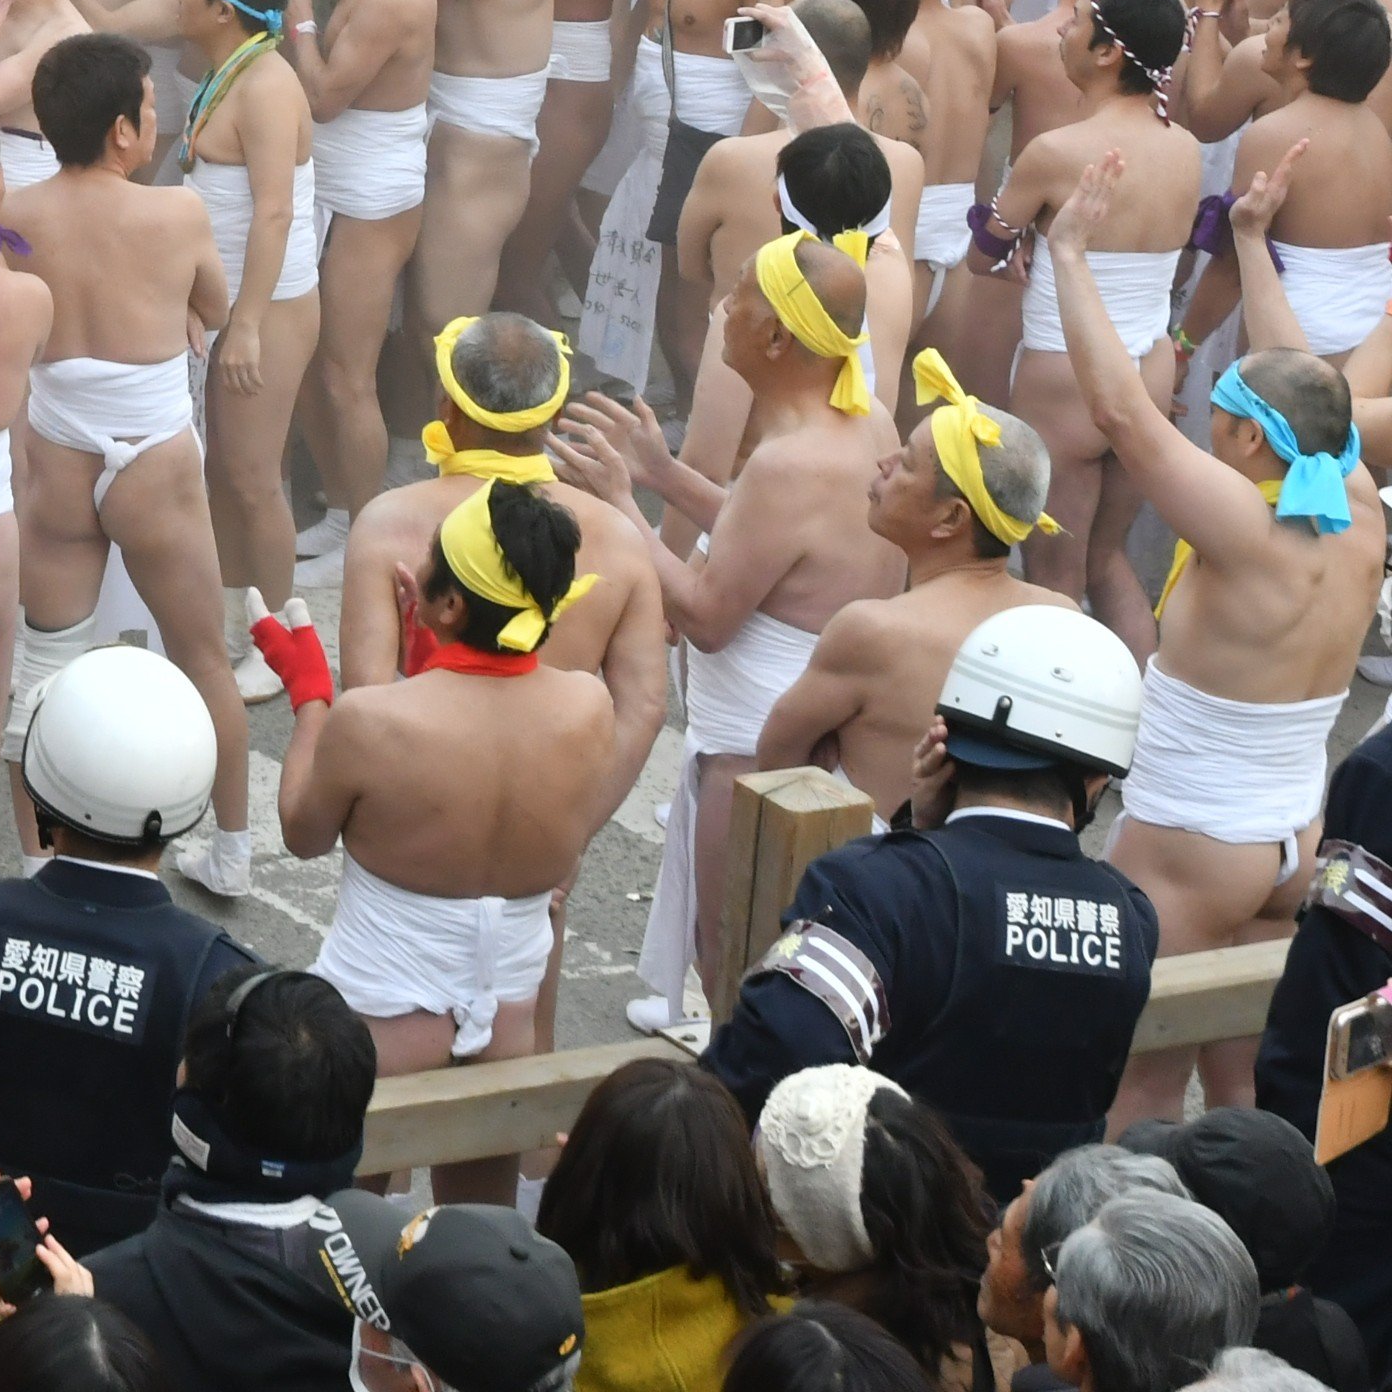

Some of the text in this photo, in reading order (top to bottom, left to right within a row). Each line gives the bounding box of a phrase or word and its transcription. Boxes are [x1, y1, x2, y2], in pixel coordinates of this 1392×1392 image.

[1007, 892, 1120, 936] 愛知県警察
[3, 937, 145, 999] 愛知県警察
[1006, 927, 1121, 969] POLICE
[324, 1232, 390, 1331] OWNER
